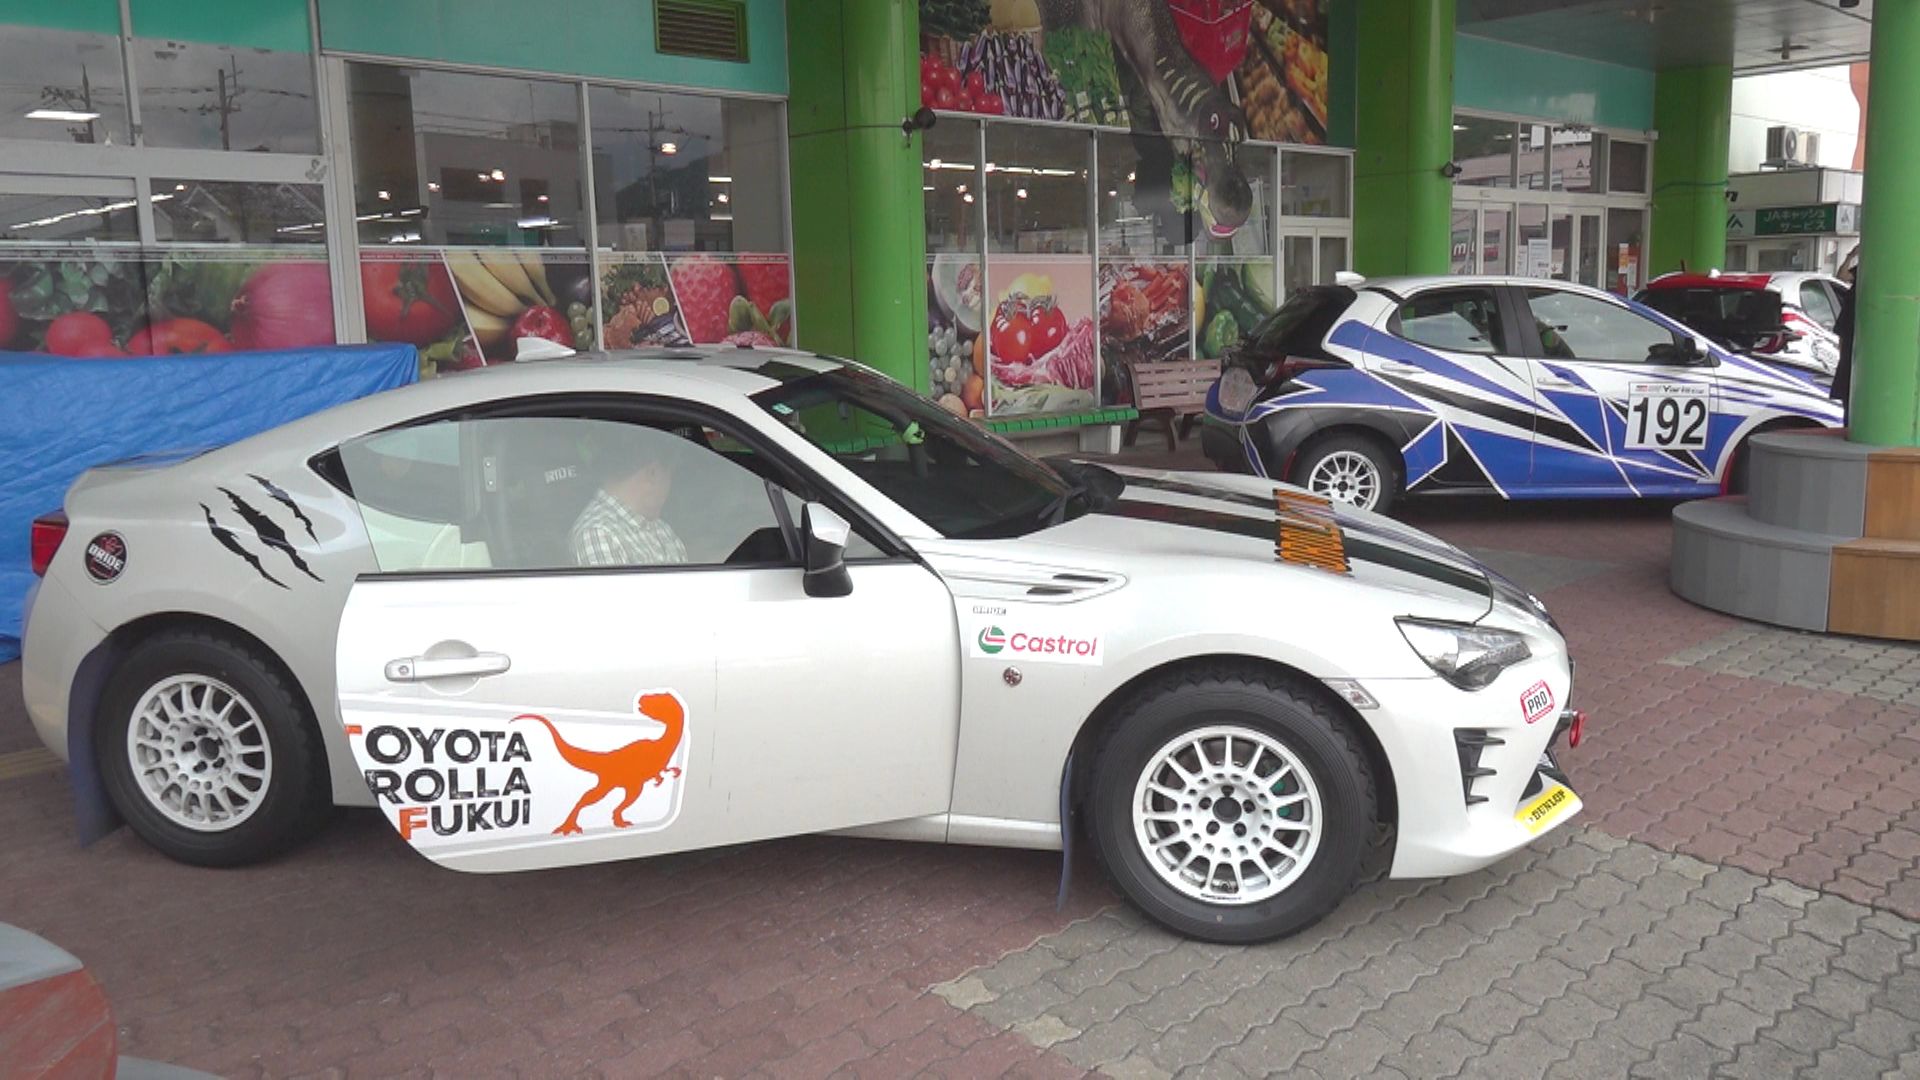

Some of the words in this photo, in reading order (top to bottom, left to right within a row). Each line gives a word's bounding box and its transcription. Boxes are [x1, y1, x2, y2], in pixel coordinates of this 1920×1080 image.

[1781, 220, 1826, 233] サービス
[1632, 397, 1706, 446] 192
[1010, 632, 1097, 657] Castrol
[1527, 690, 1549, 714] PRO
[1532, 789, 1567, 820] DUNLOP
[398, 798, 531, 840] FUKUI
